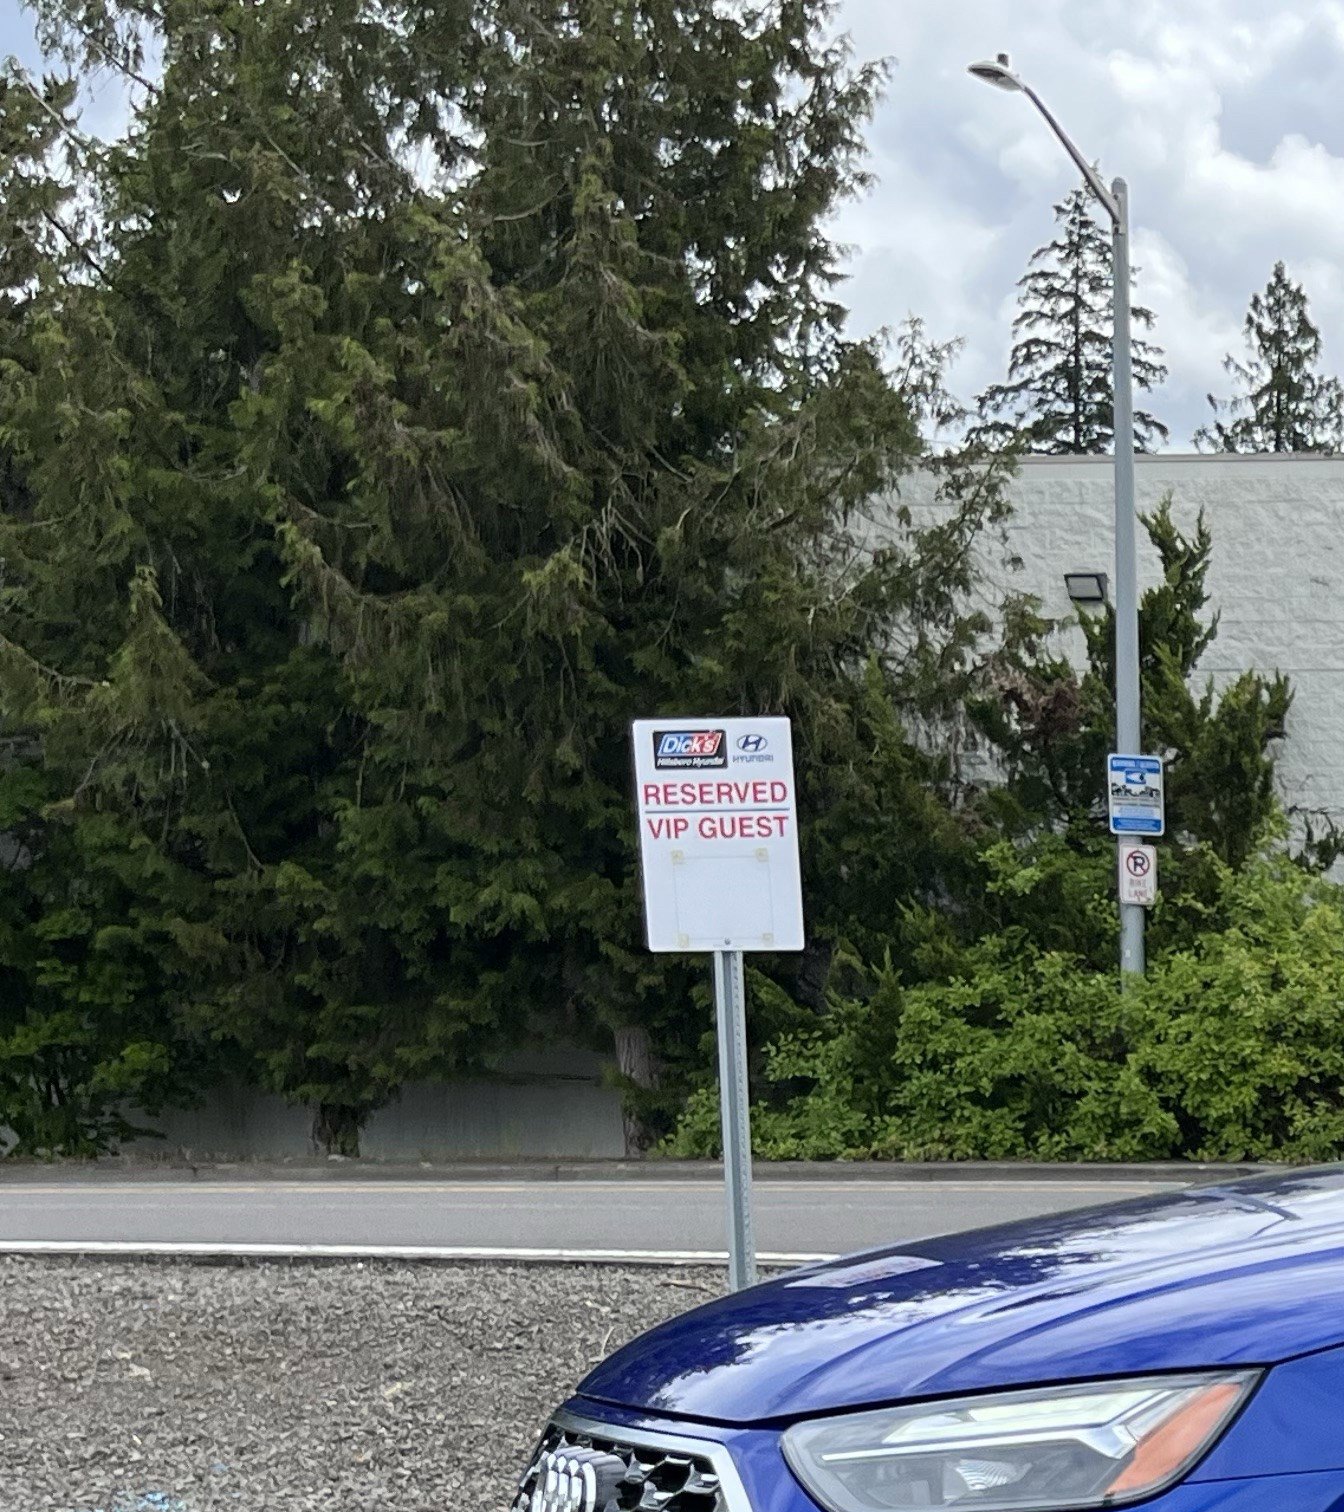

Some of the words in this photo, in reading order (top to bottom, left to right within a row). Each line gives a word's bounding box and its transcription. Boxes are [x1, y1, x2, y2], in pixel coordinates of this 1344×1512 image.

[643, 781, 788, 805] RESERVED
[647, 818, 689, 840] VIP
[698, 816, 789, 839] GUEST
